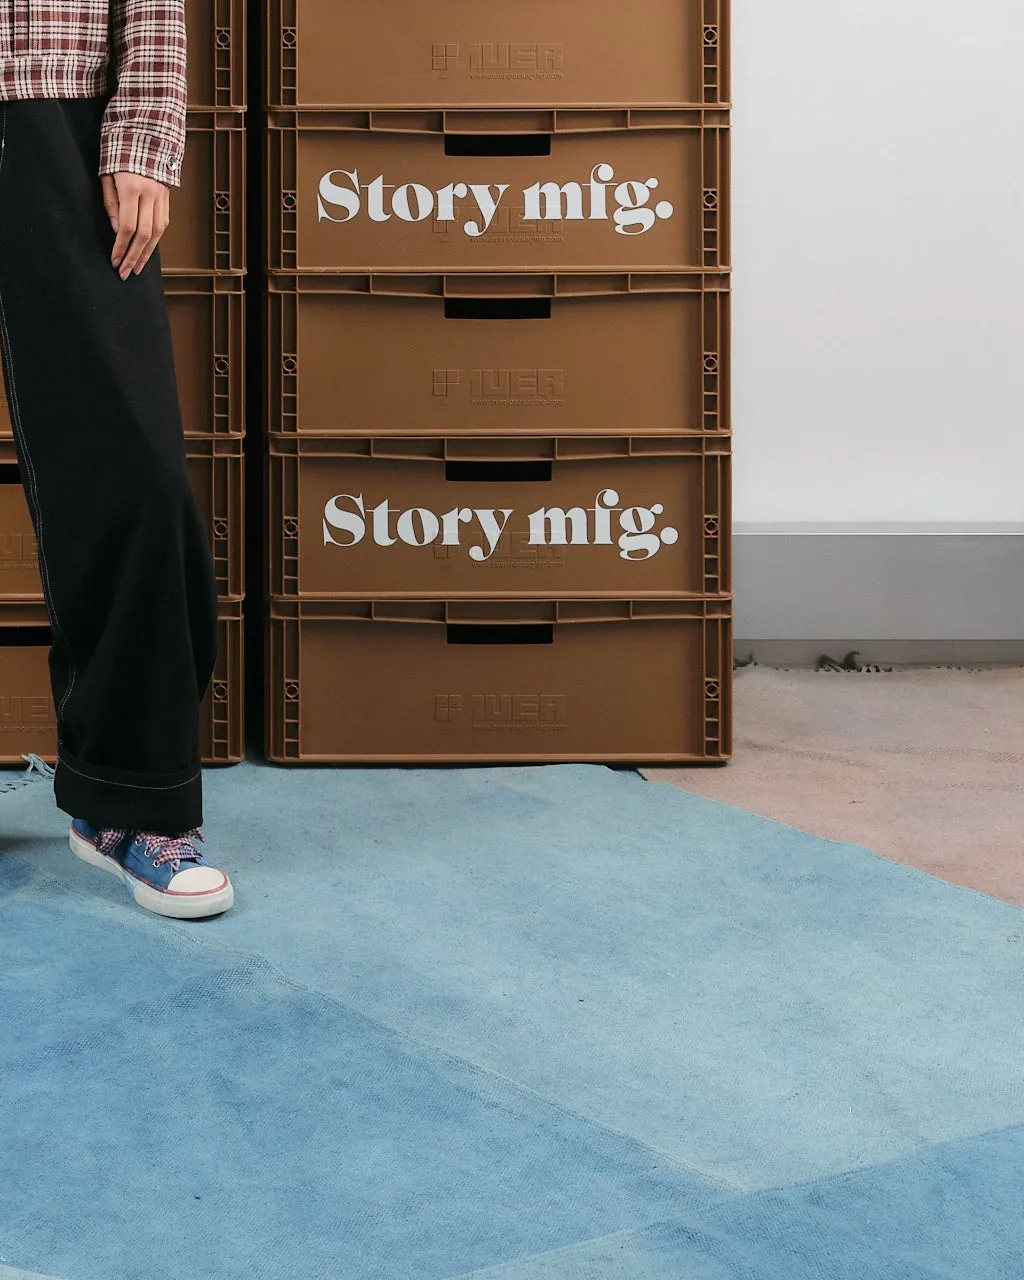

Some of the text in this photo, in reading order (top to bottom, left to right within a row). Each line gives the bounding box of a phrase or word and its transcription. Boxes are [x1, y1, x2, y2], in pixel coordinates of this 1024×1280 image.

[317, 163, 673, 236] Story mfg.
[323, 489, 678, 561] Story mfg.
